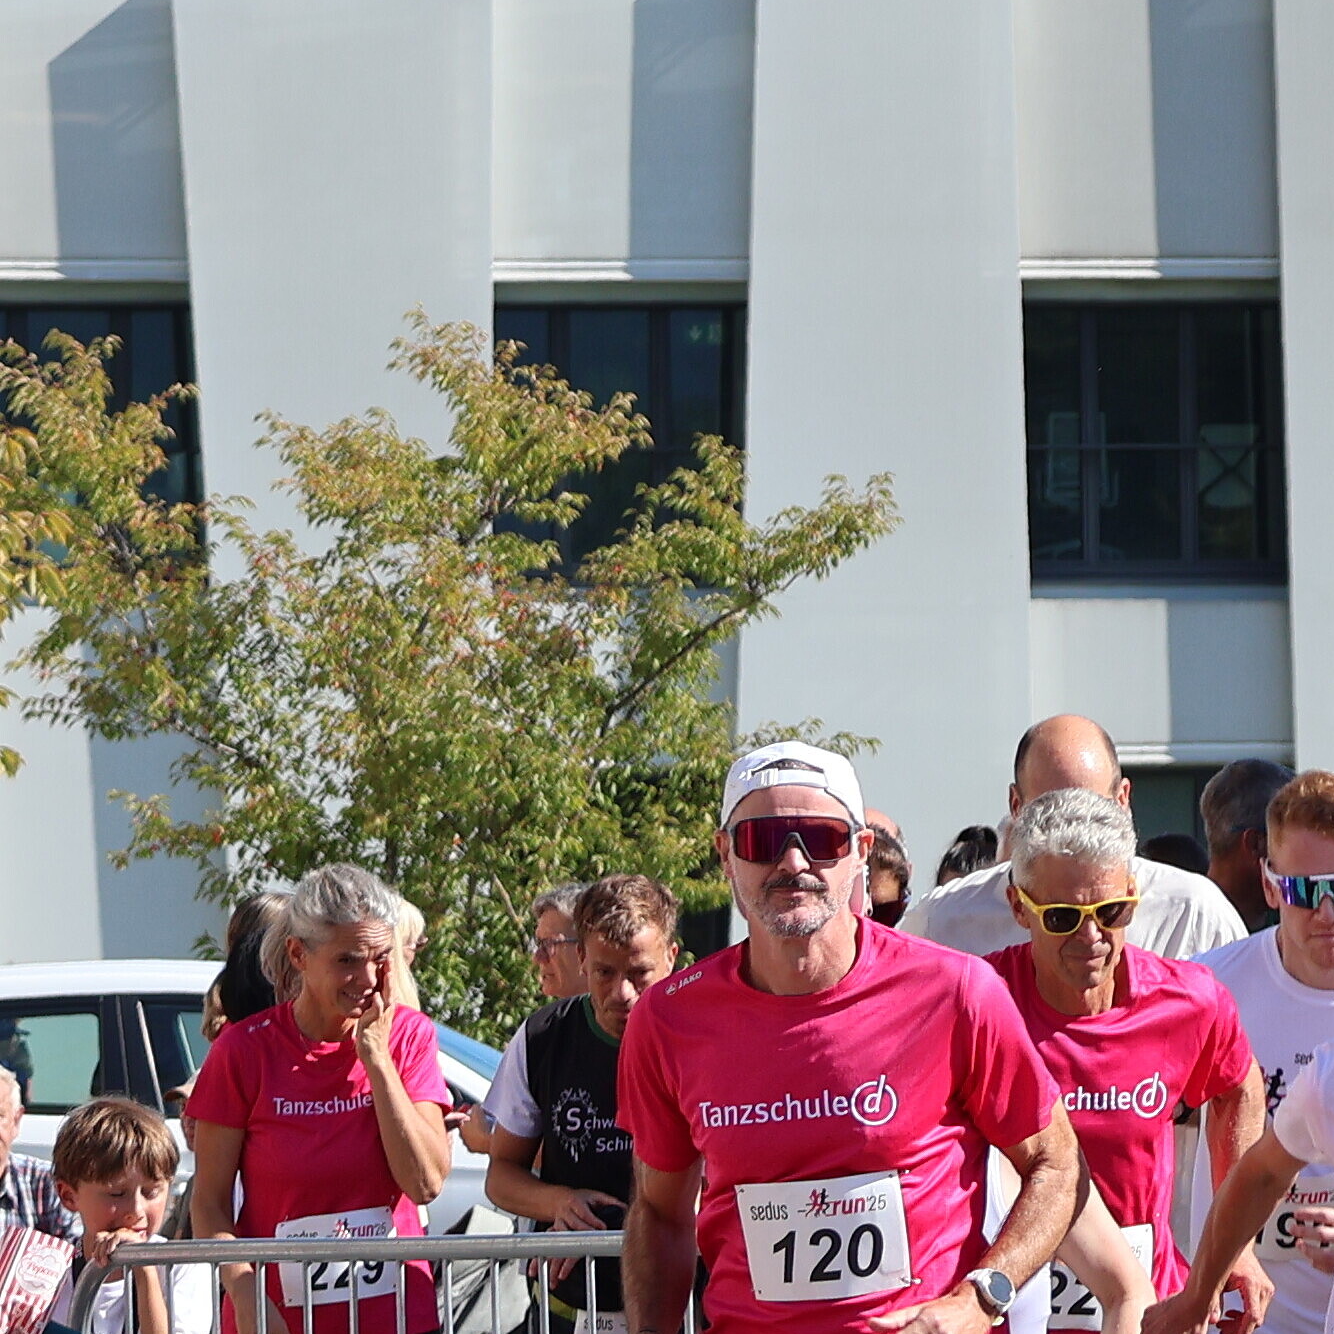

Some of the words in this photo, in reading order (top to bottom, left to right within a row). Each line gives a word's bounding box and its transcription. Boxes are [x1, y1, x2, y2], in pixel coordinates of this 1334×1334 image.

[678, 970, 703, 988] JAKO
[273, 1092, 373, 1116] Tanzschule
[698, 1089, 850, 1128] Tanzschule
[750, 1201, 789, 1221] sedus
[773, 1223, 884, 1283] 120
[584, 1317, 614, 1331] sdus
